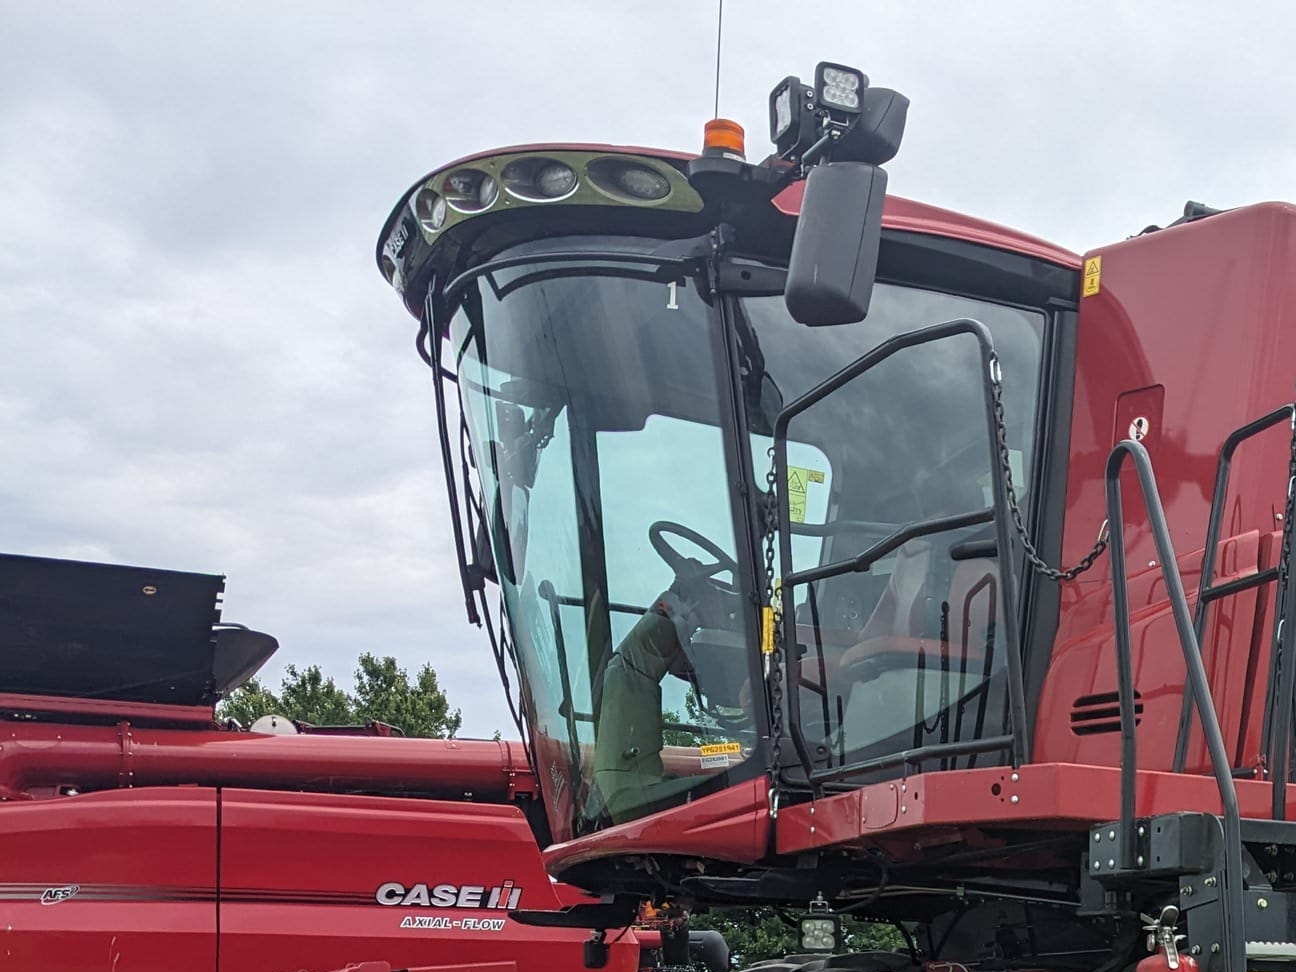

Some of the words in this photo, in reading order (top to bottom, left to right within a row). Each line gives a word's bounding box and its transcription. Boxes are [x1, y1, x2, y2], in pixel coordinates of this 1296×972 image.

[666, 280, 679, 310] 1
[42, 889, 71, 899] AFS
[375, 882, 485, 908] CASE
[487, 879, 522, 909] IH
[400, 916, 505, 931] AXIAL-FLOW
